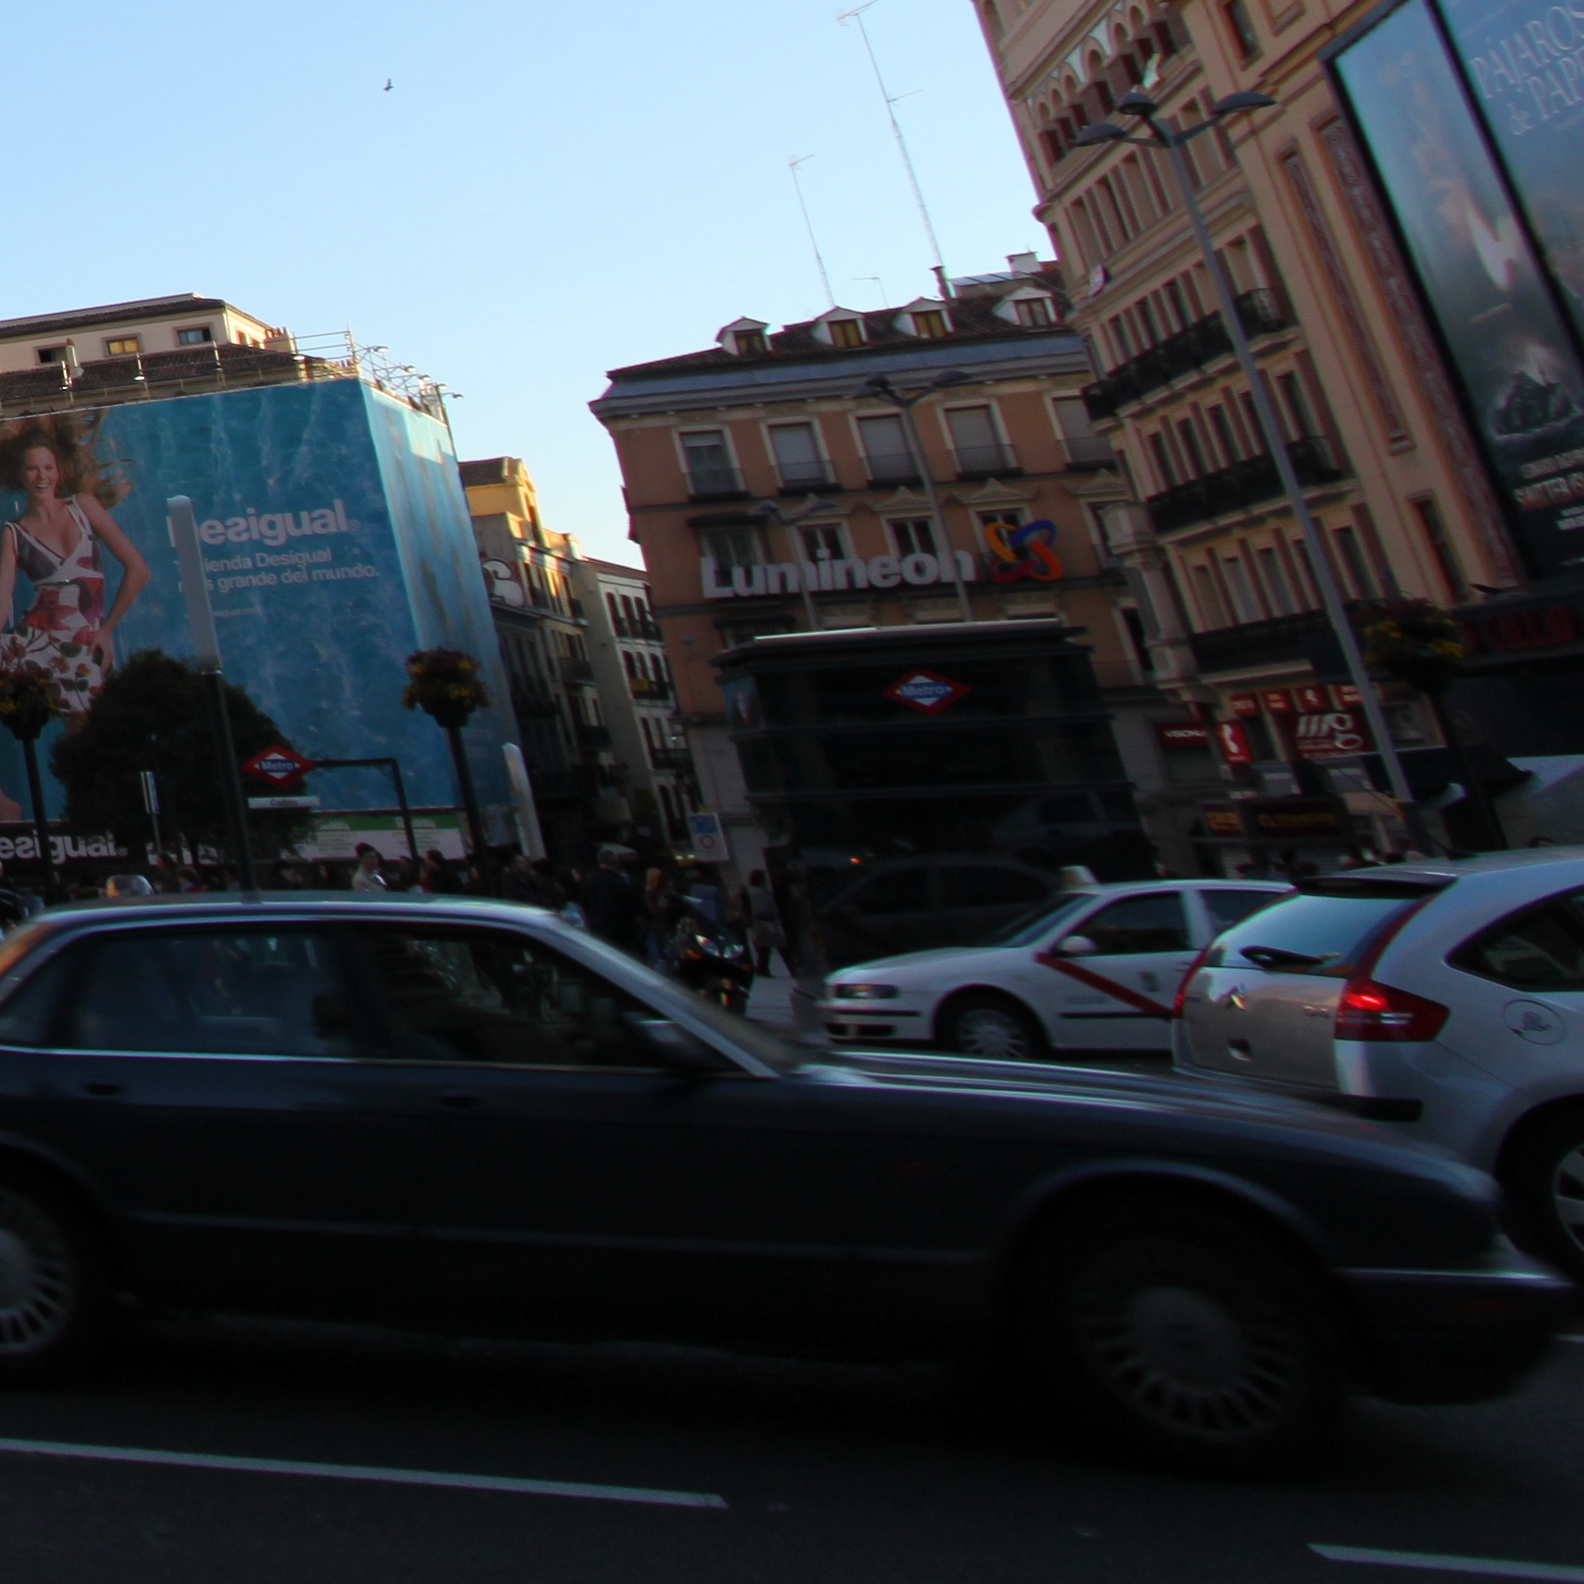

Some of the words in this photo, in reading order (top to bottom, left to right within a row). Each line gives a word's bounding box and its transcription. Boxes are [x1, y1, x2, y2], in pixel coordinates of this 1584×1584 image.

[167, 498, 349, 547] esigual
[203, 556, 253, 573] ienda
[255, 547, 333, 567] Desigual
[700, 548, 976, 598] Lumineon
[218, 570, 278, 594] grande
[281, 565, 309, 585] del
[901, 684, 948, 700] Metro
[261, 759, 295, 774] Metro
